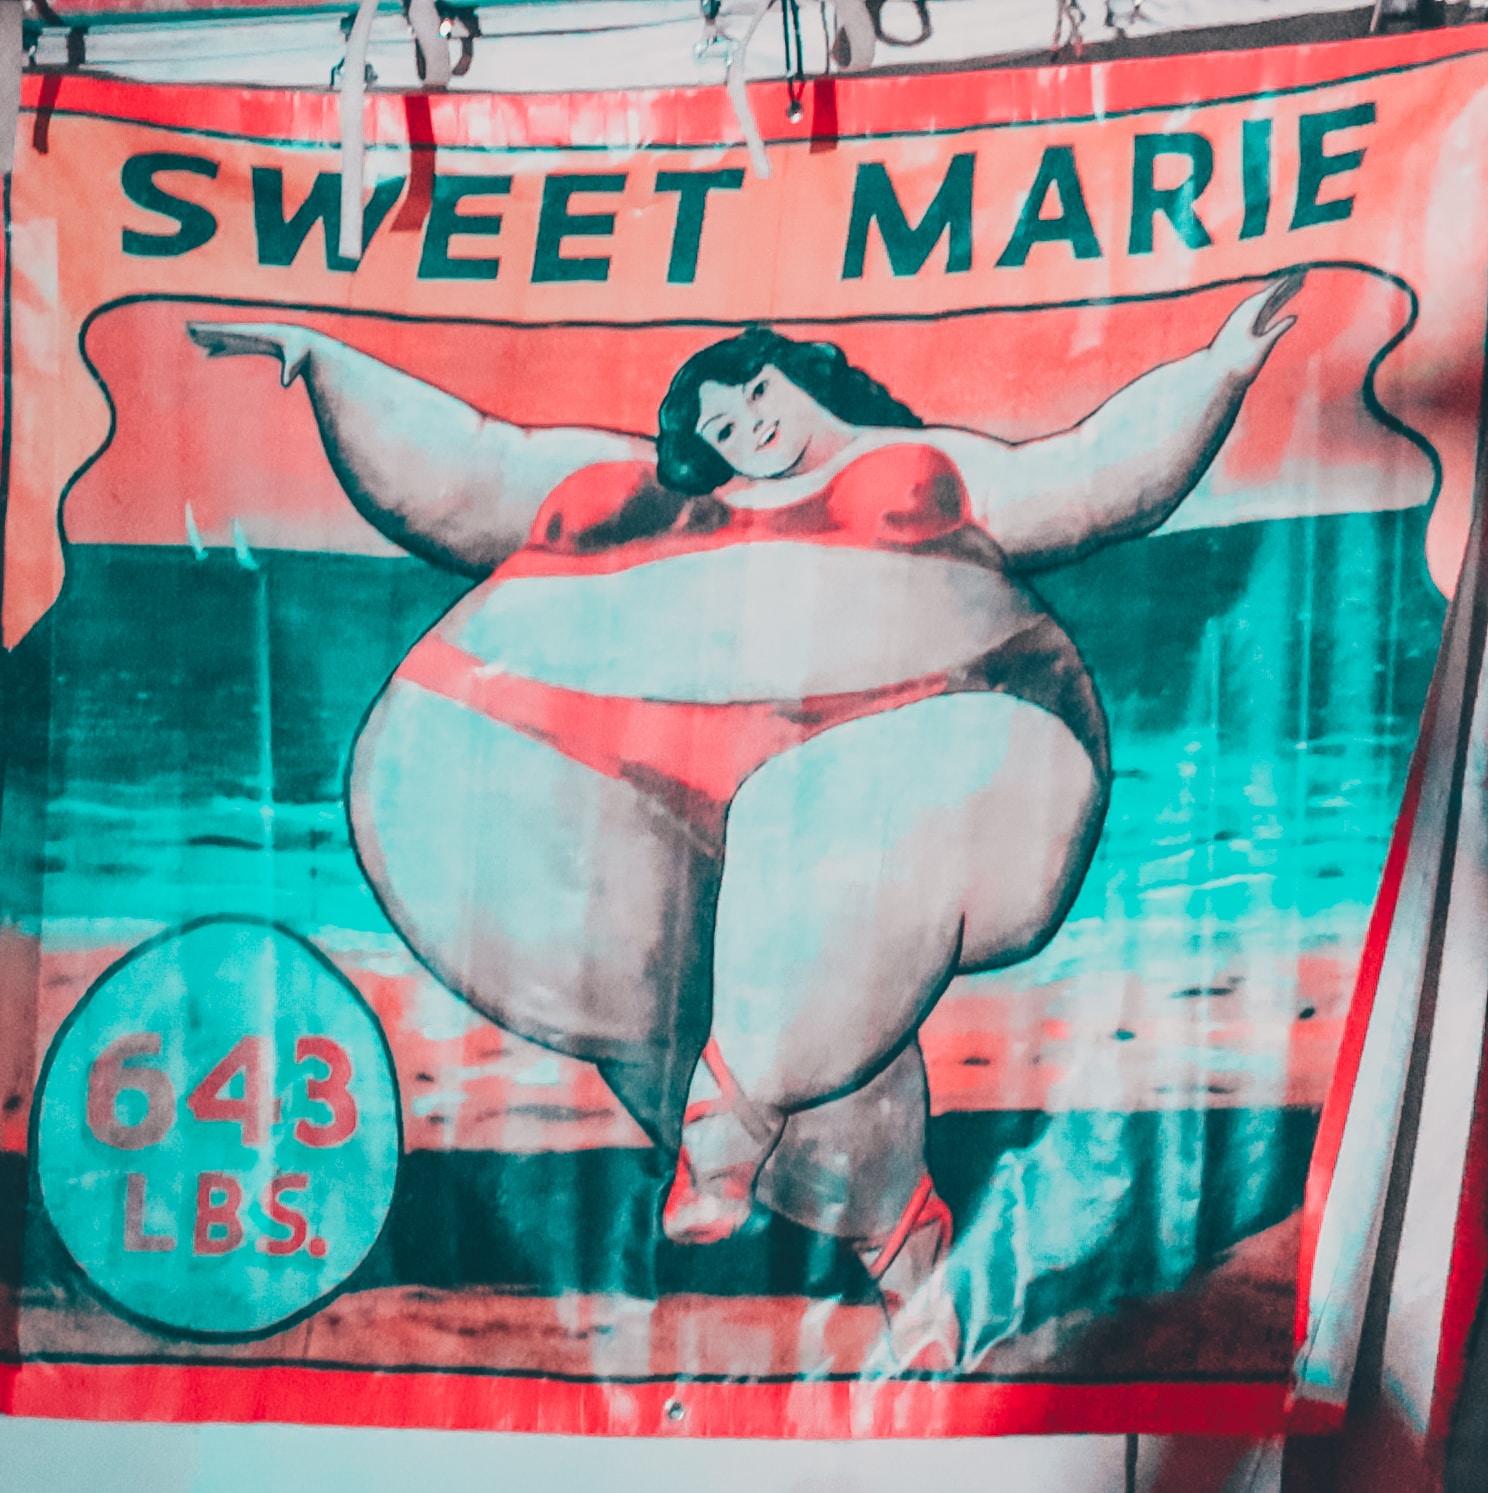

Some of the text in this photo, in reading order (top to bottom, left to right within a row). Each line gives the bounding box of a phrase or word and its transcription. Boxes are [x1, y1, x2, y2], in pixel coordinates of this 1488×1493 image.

[119, 101, 1377, 286] SWEET MARIE
[85, 1030, 359, 1151] 643
[122, 1170, 329, 1259] LBS.
